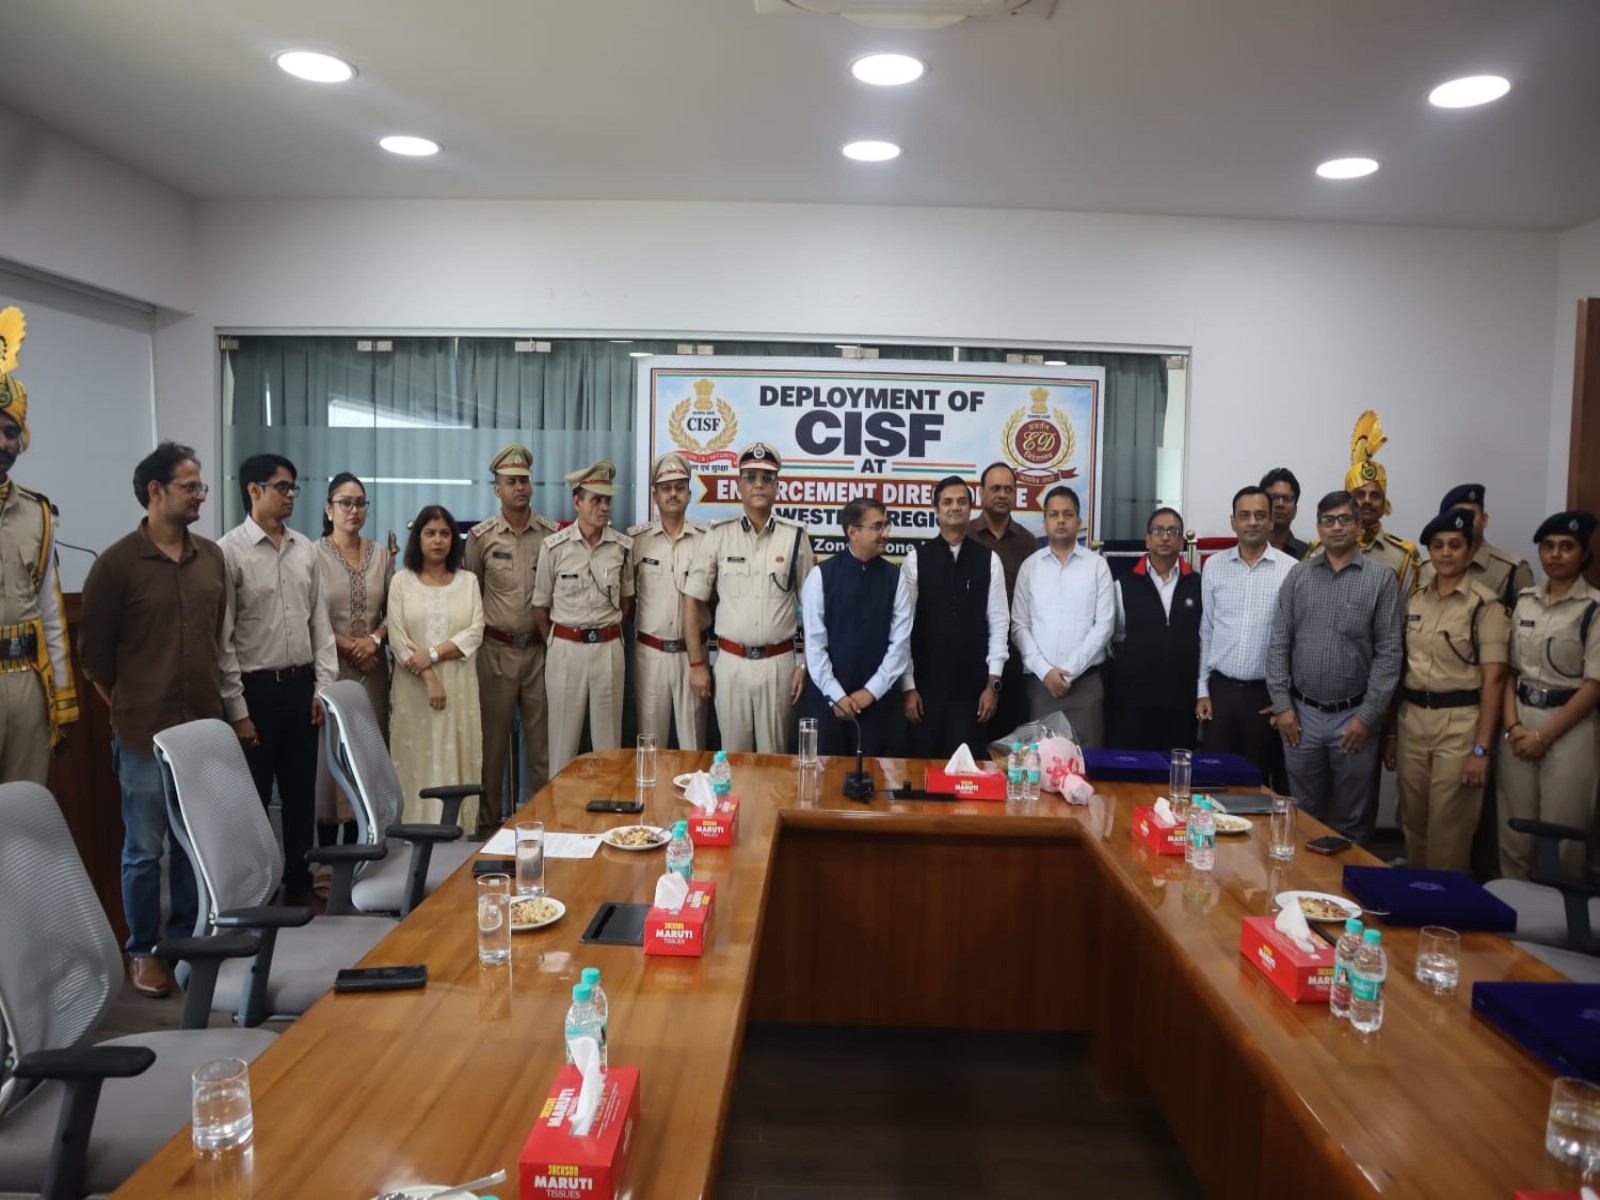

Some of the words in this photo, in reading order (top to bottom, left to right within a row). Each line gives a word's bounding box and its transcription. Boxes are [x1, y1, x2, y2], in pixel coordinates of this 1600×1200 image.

[759, 385, 941, 410] DEPLOYMENT
[948, 390, 985, 412] OF
[686, 417, 720, 432] CISF
[795, 410, 944, 457] CISF
[1022, 431, 1057, 452] ED
[860, 459, 887, 474] AT
[717, 479, 876, 504] ENRCEMENT
[775, 508, 843, 525] WEST
[886, 510, 940, 528] REGI
[814, 538, 850, 552] Zon
[885, 542, 915, 554] one
[655, 929, 693, 939] MARUTI
[534, 1175, 593, 1190] MARUTI
[546, 1189, 581, 1199] TISSUES
